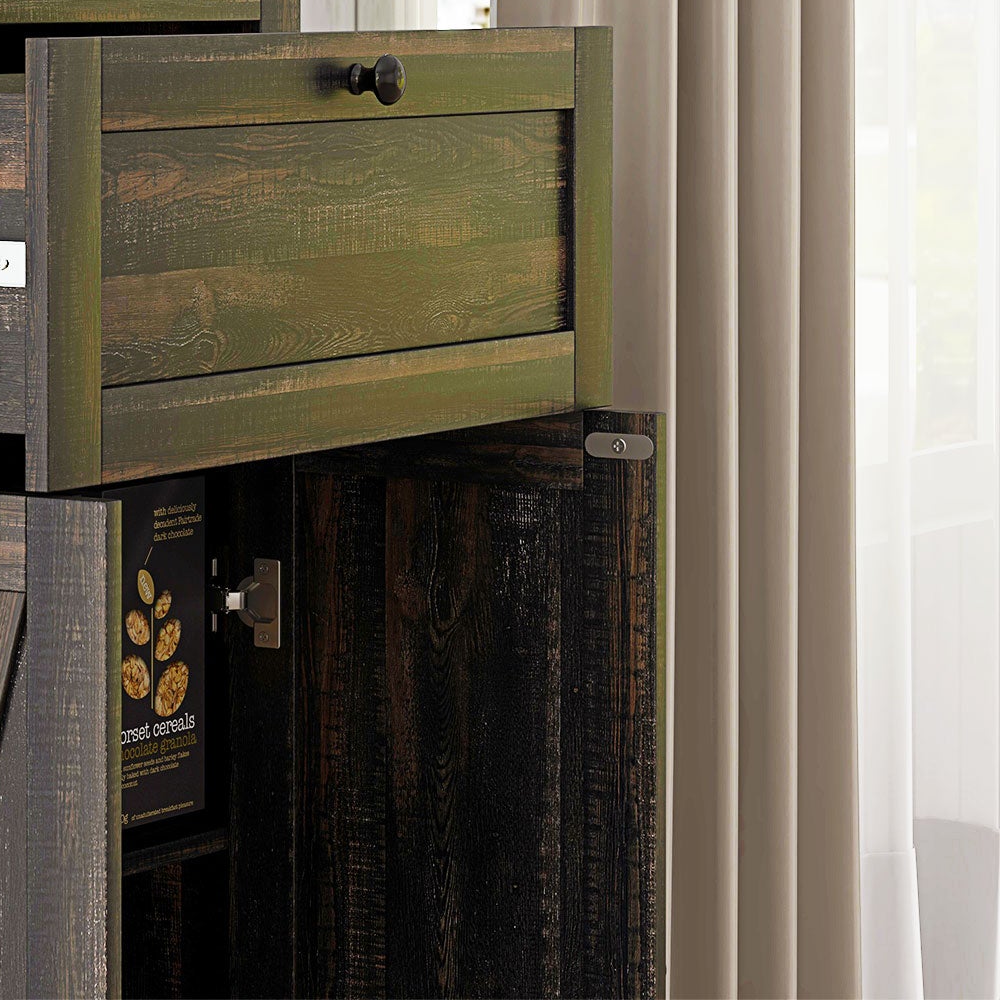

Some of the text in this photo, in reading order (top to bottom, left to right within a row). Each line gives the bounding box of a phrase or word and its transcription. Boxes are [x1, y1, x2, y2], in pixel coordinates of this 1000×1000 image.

[154, 502, 197, 517] with deliciously
[178, 514, 202, 525] Fairtrade
[154, 528, 194, 541] dark chocolate
[140, 575, 152, 600] new
[121, 713, 195, 744] orset cereals
[160, 731, 197, 754] granola
[150, 766, 160, 774] dark
